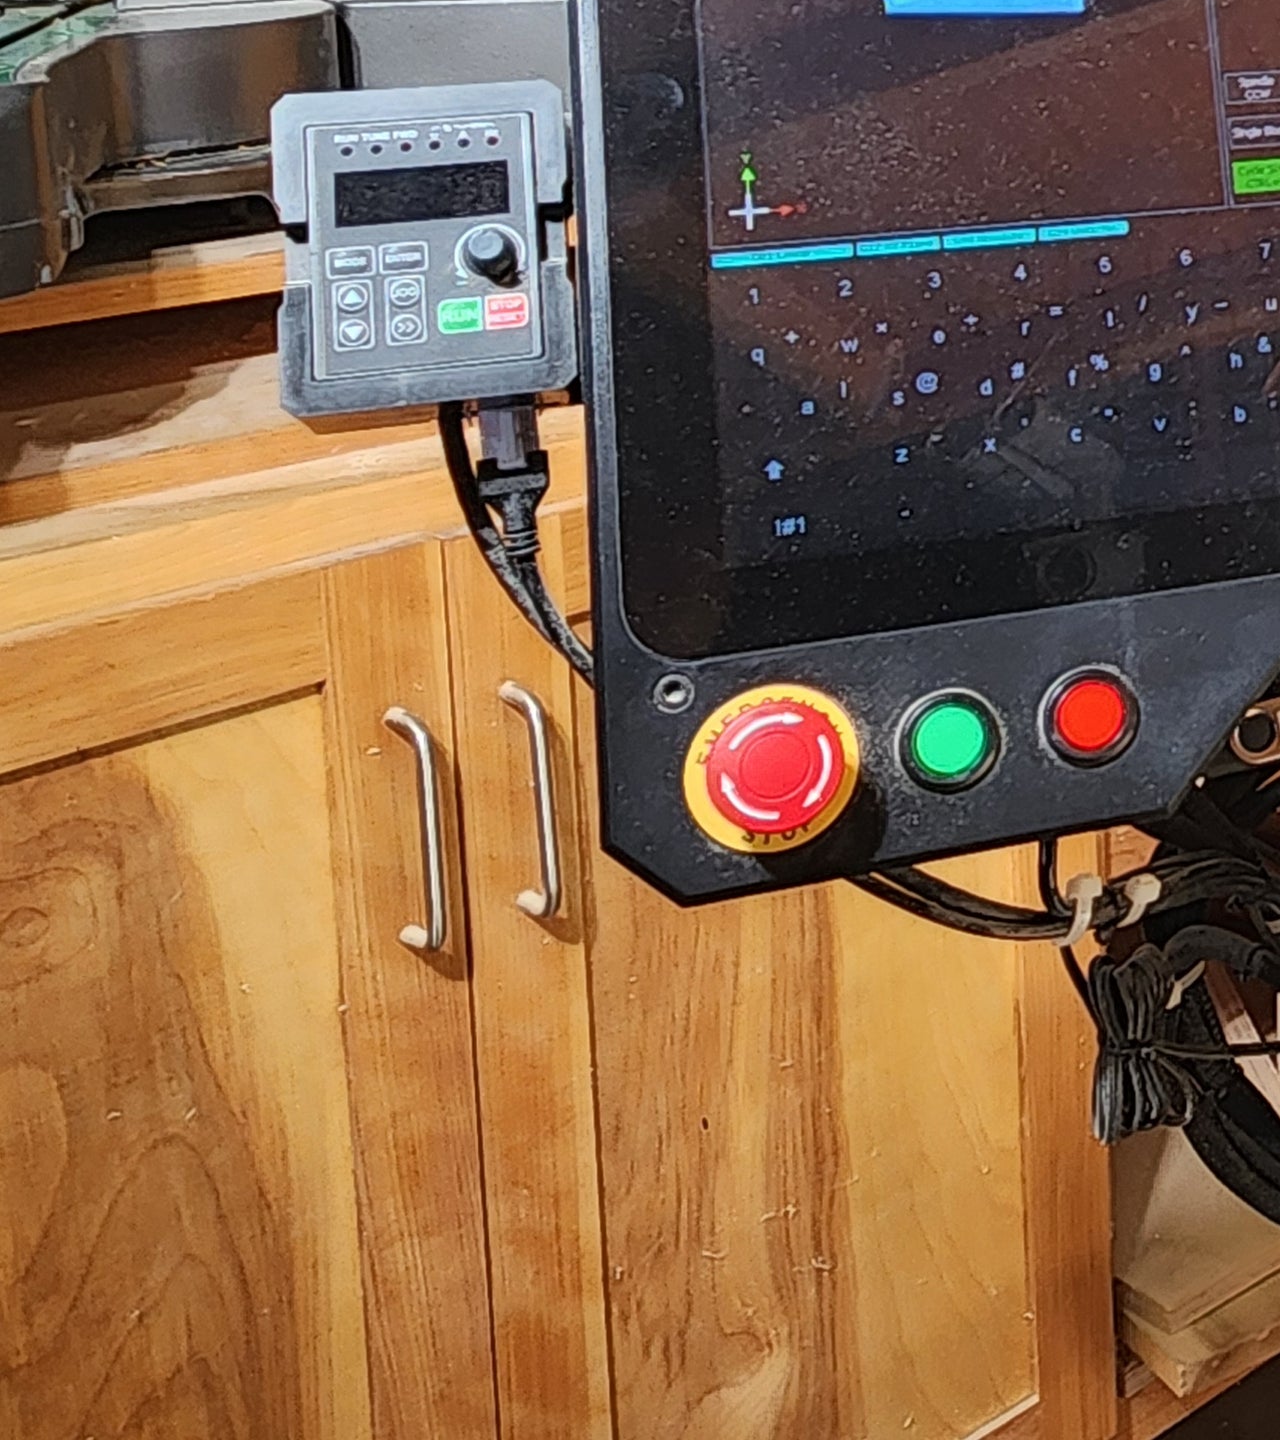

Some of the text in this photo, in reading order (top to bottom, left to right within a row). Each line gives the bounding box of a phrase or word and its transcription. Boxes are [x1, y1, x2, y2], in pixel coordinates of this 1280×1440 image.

[1179, 248, 1194, 266] 6
[1259, 241, 1273, 260] 7
[927, 271, 942, 289] 3
[1013, 263, 1028, 281] 4
[749, 287, 760, 305] 1
[838, 279, 853, 298] 2
[1265, 297, 1279, 311] u
[442, 306, 478, 325] RUN
[1185, 303, 1200, 327] y
[839, 337, 860, 354] w
[751, 348, 766, 367] q
[1089, 352, 1110, 372] %
[1148, 362, 1163, 383] g
[915, 371, 939, 394] @
[979, 377, 993, 396] d
[892, 390, 906, 406] s
[801, 400, 815, 416] a
[1234, 405, 1248, 423] b
[1153, 416, 1168, 433] v
[1070, 427, 1083, 443] c
[983, 437, 998, 454] x
[894, 447, 910, 464] z
